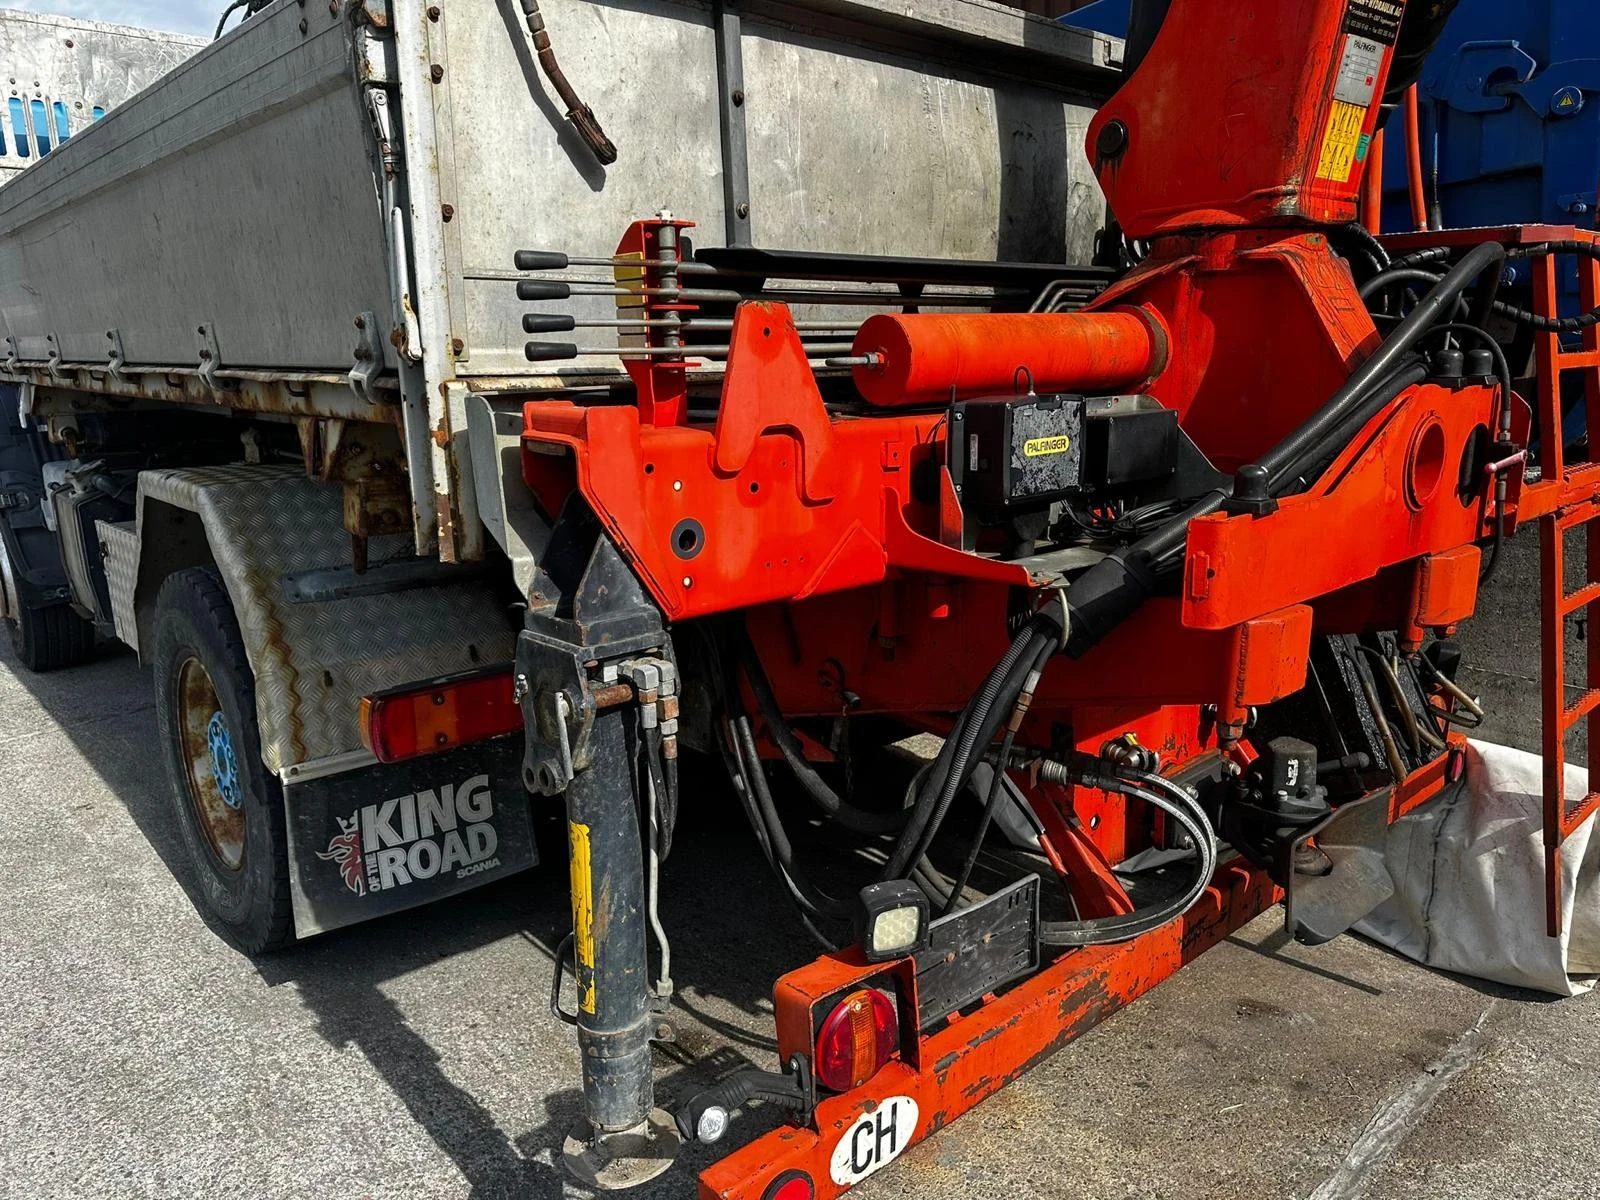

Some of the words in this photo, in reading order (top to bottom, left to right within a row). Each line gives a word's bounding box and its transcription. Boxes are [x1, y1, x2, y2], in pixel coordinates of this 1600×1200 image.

[1027, 438, 1066, 453] PALFINGER
[361, 774, 493, 852] KING
[376, 822, 498, 891] ROAD
[456, 858, 501, 880] SCANIA
[368, 876, 381, 892] OF
[851, 1103, 897, 1174] CH
